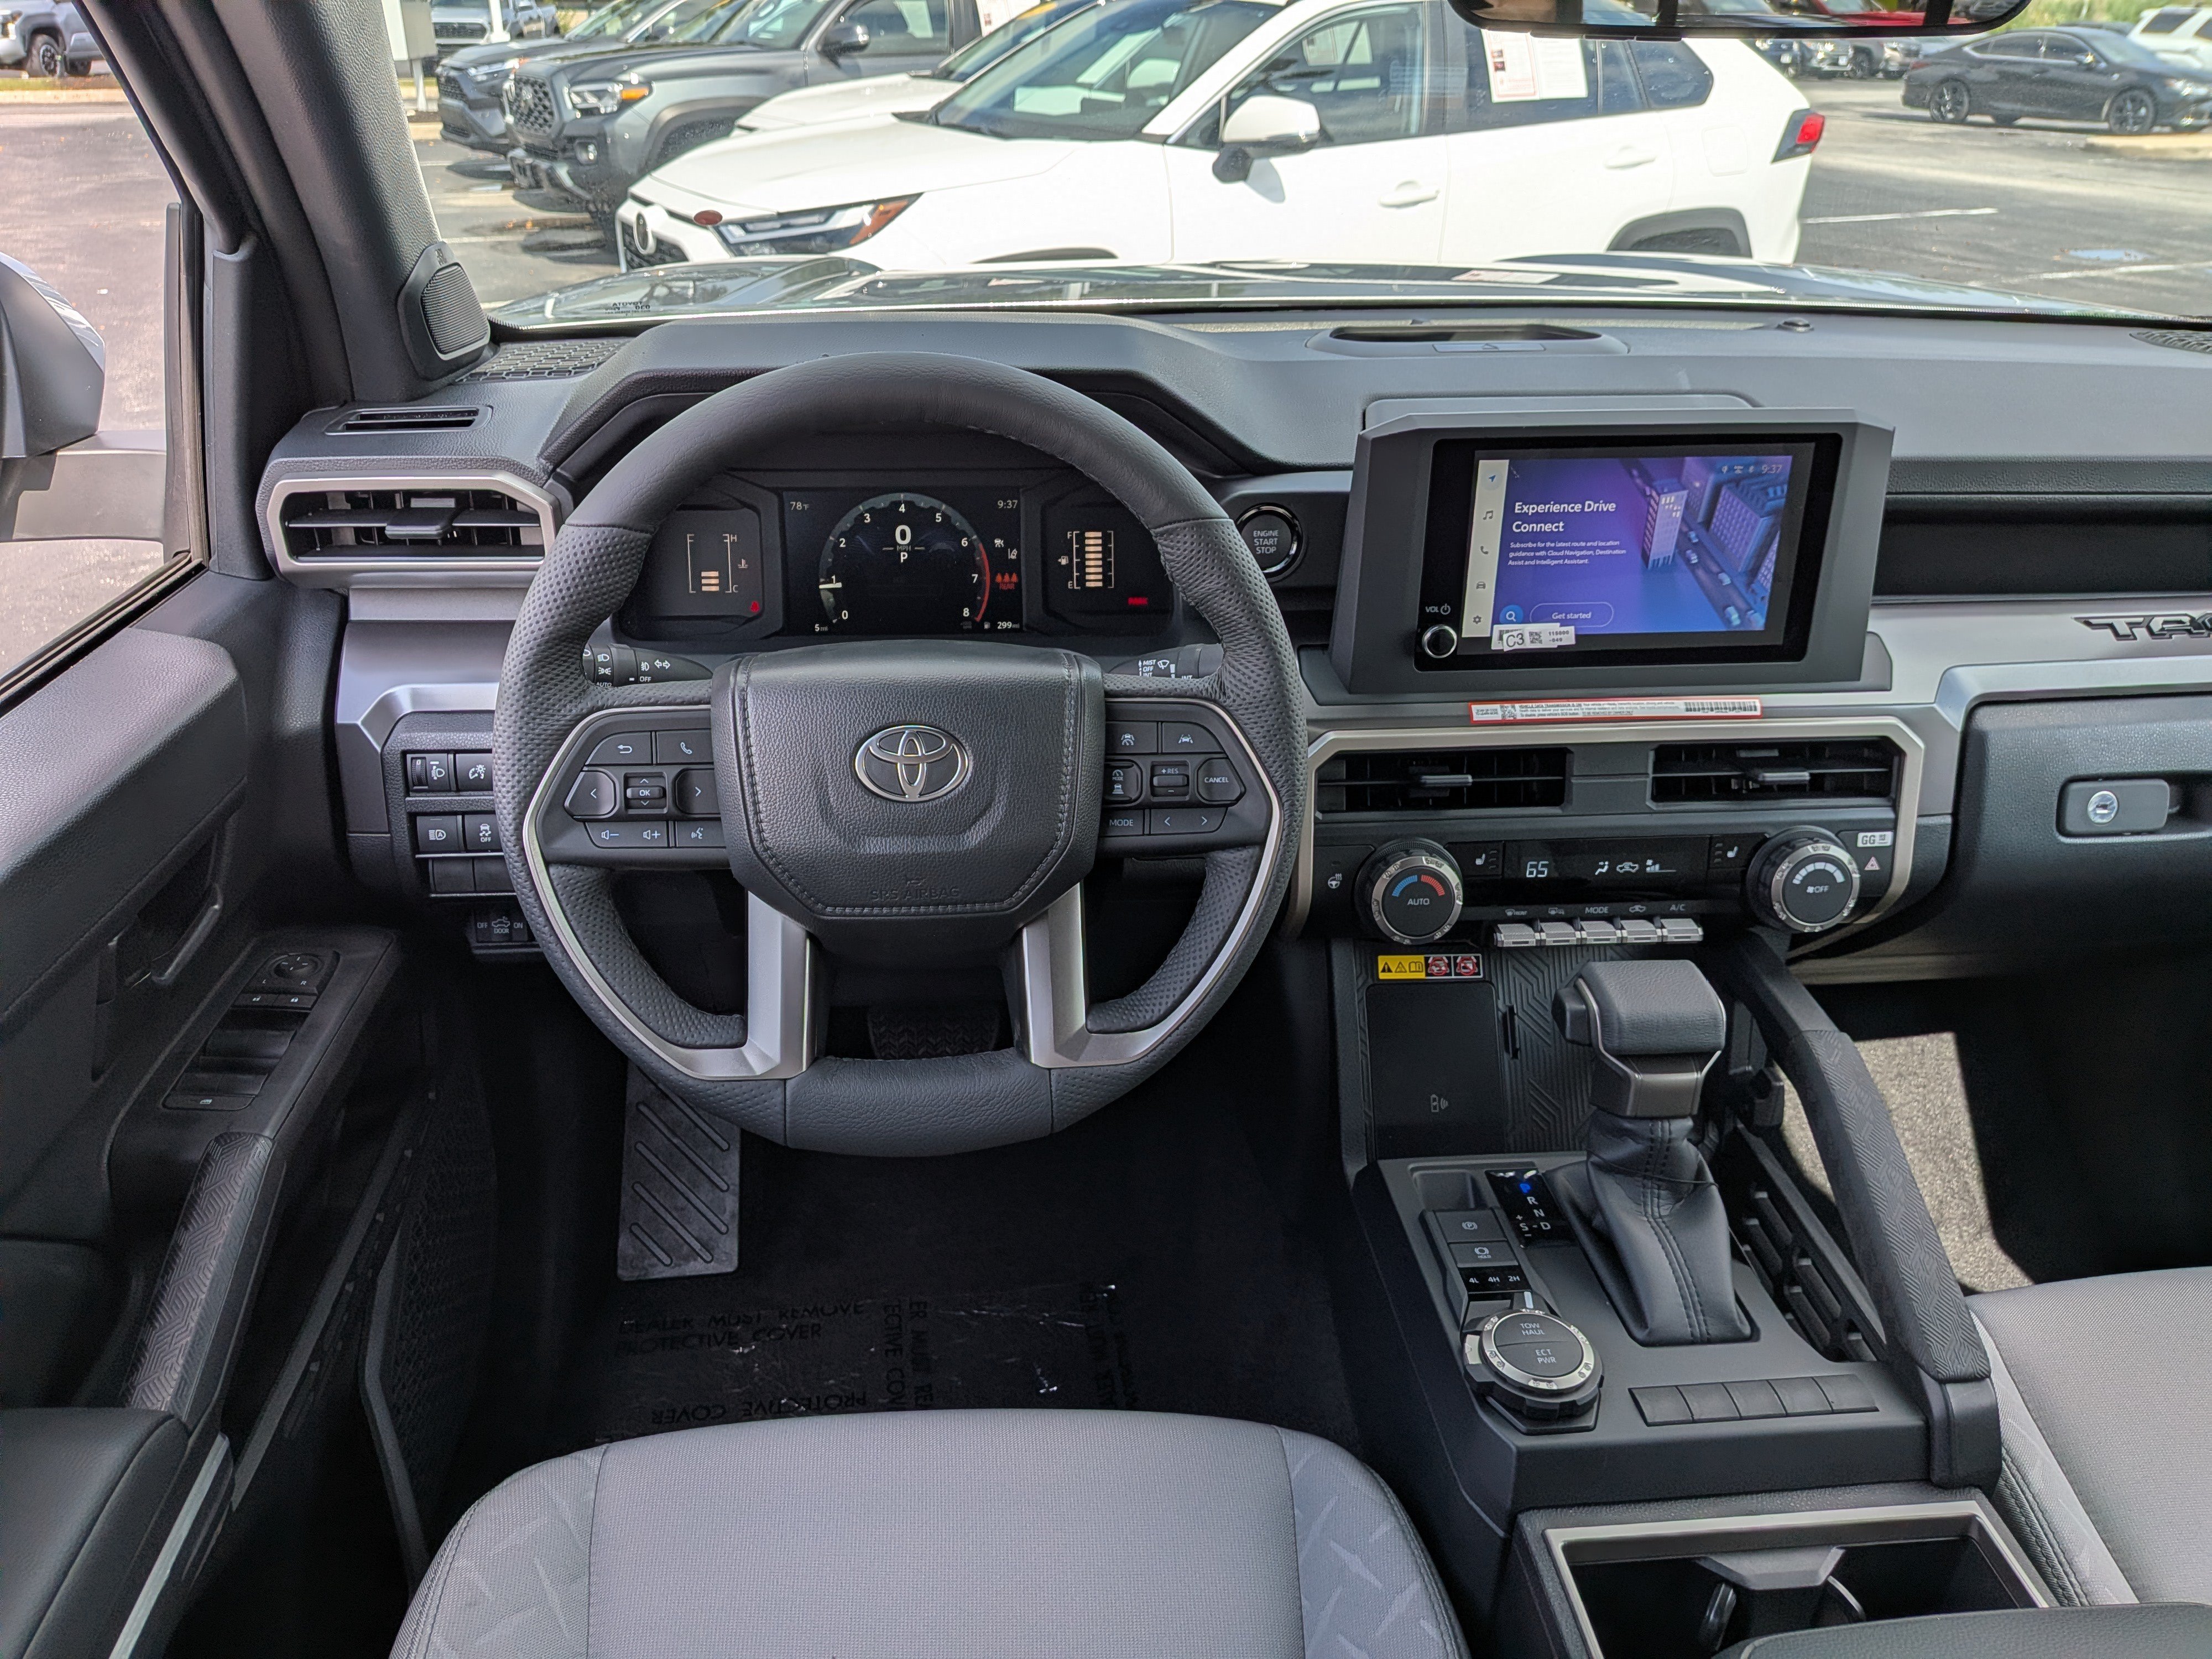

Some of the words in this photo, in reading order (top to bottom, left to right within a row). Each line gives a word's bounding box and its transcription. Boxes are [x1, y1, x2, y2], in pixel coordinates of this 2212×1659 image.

[1762, 465, 1782, 473] 9:37
[899, 504, 905, 513] 4
[998, 500, 1018, 509] 9:37
[1515, 501, 1582, 515] Experience
[1584, 500, 1616, 512] Drive
[864, 513, 870, 523] 3
[936, 513, 941, 522] 5
[1512, 521, 1564, 533] Connect
[895, 525, 911, 545] 0
[839, 538, 846, 547] 2
[961, 537, 968, 547] 6
[901, 552, 907, 562] P
[831, 575, 836, 583] 1
[972, 574, 978, 583] 7
[842, 610, 848, 619] 0
[963, 608, 969, 617] 8
[1506, 633, 1524, 648] C3
[1526, 861, 1549, 878] 65
[904, 887, 959, 900] AIRBAG
[1585, 906, 1609, 914] MODE
[1670, 904, 1686, 912] A/C
[1527, 1196, 1538, 1204] R
[709, 1313, 761, 1327] MUST
[779, 1302, 866, 1319] REMOVE
[752, 1322, 823, 1342] COVER
[651, 1404, 727, 1425] COVER
